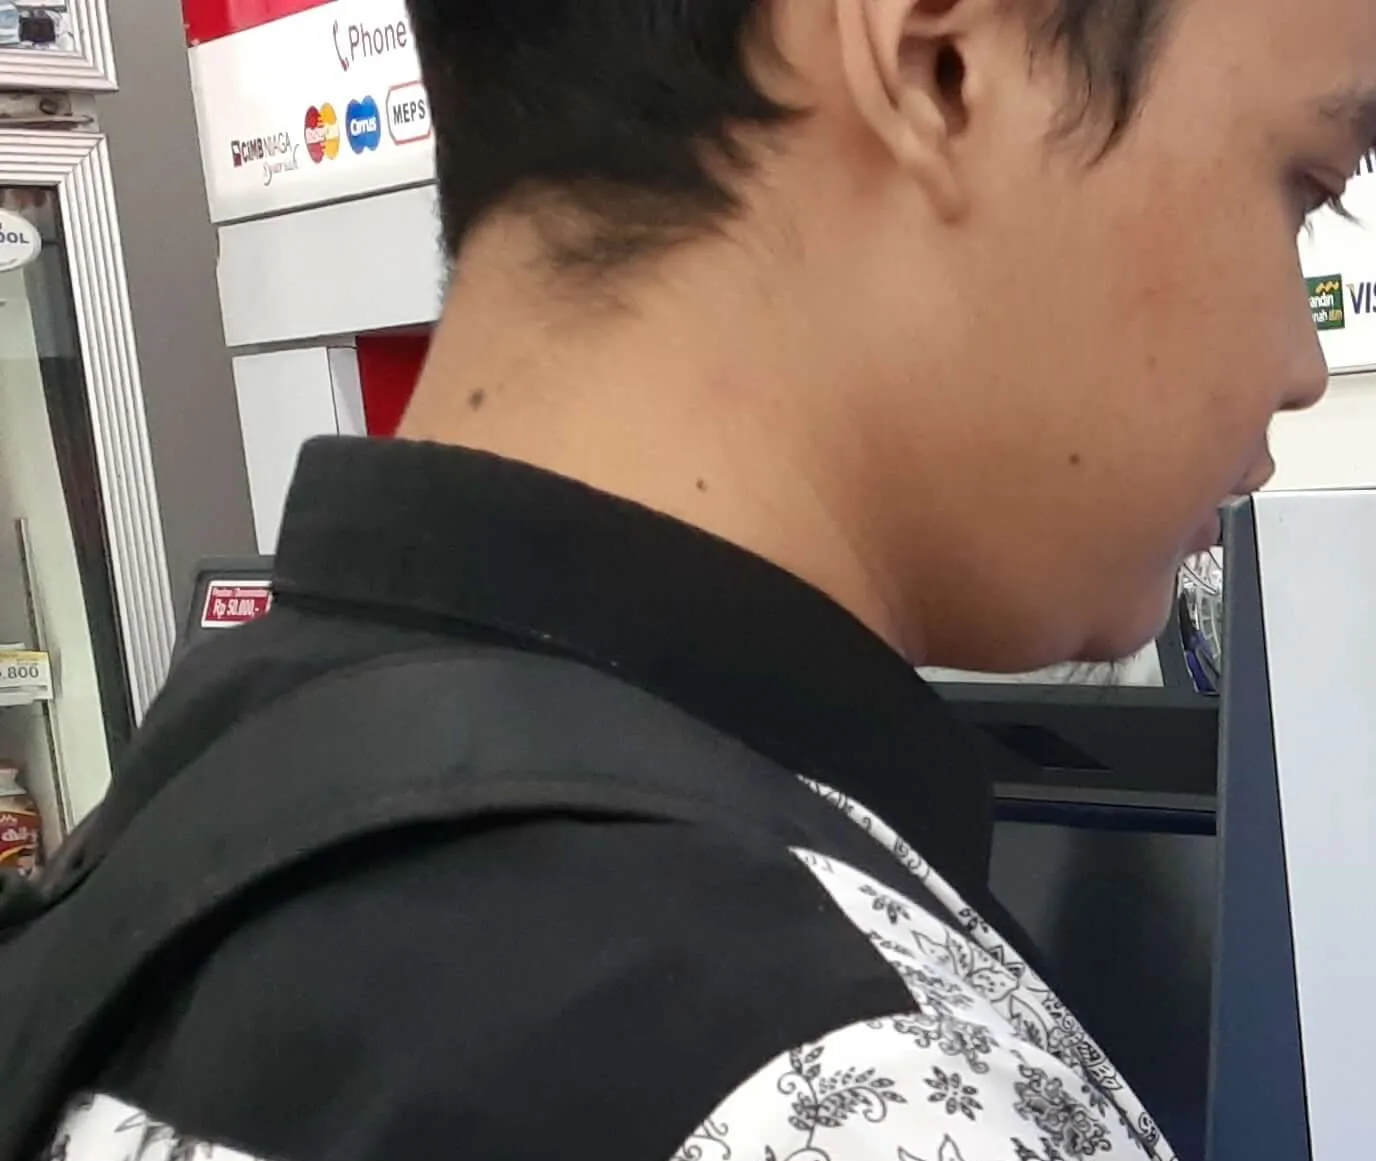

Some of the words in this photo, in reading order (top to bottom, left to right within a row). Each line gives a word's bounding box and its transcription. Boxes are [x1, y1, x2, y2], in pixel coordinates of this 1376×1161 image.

[348, 20, 407, 61] Phone
[392, 99, 427, 125] MEPS
[0, 666, 40, 680] .800
